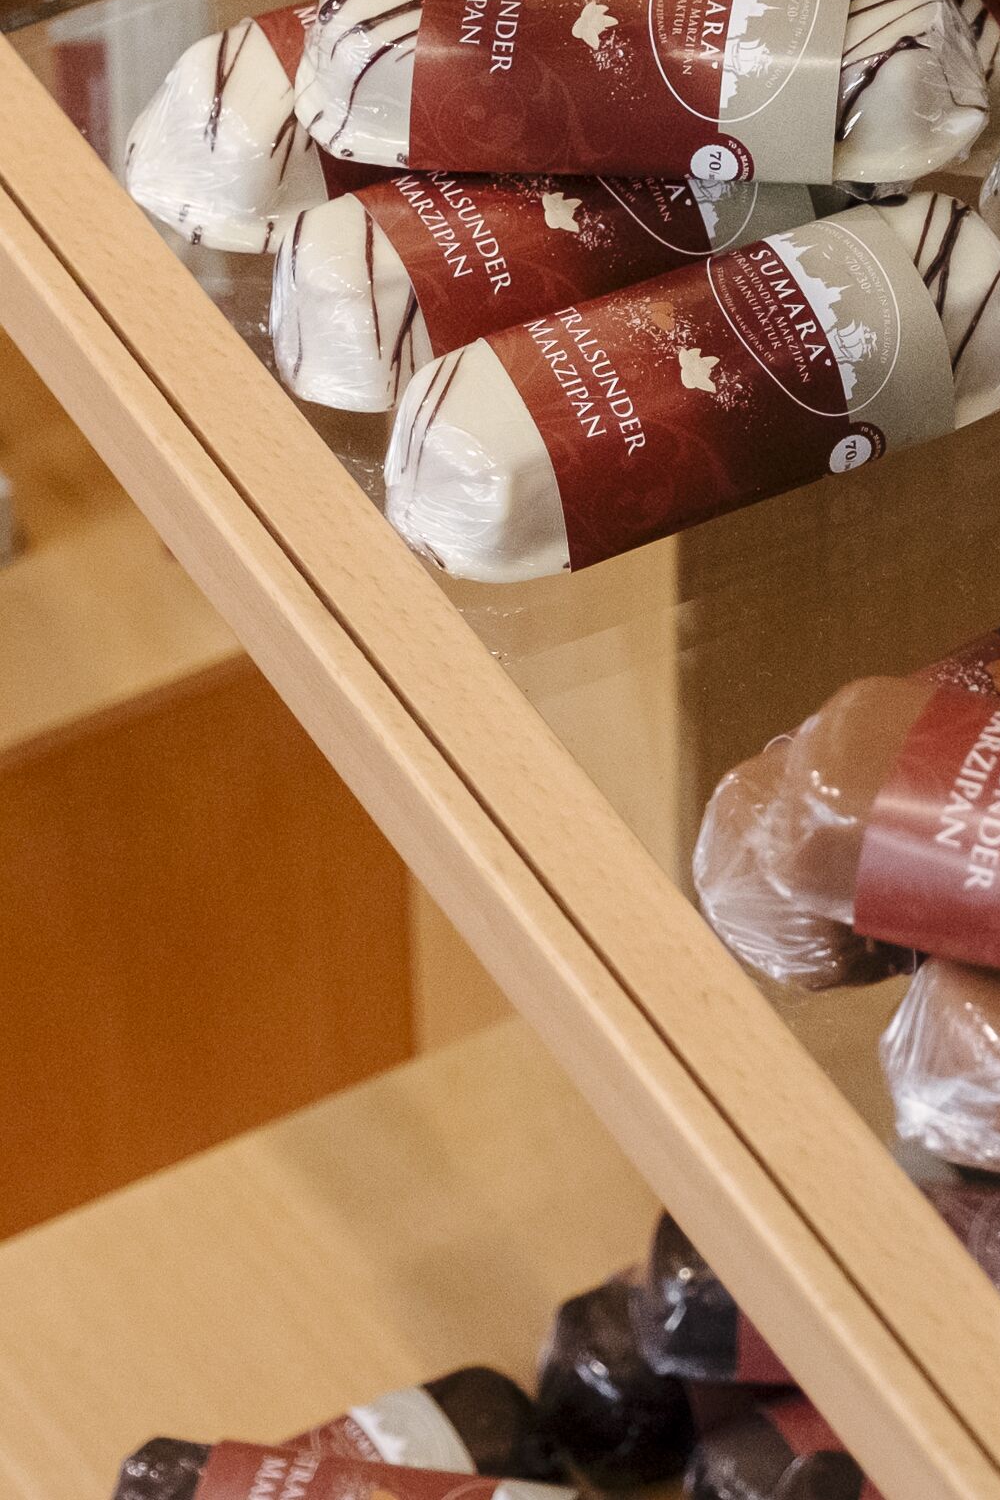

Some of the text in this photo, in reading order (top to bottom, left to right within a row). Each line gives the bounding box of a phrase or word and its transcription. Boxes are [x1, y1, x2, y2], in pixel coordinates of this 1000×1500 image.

[390, 174, 473, 278] MARZIPAN
[732, 275, 783, 350] MANUFAKTUR
[749, 249, 827, 362] SUMARA
[775, 316, 812, 383] MARZIPAN
[523, 318, 607, 439] MARZIPAN
